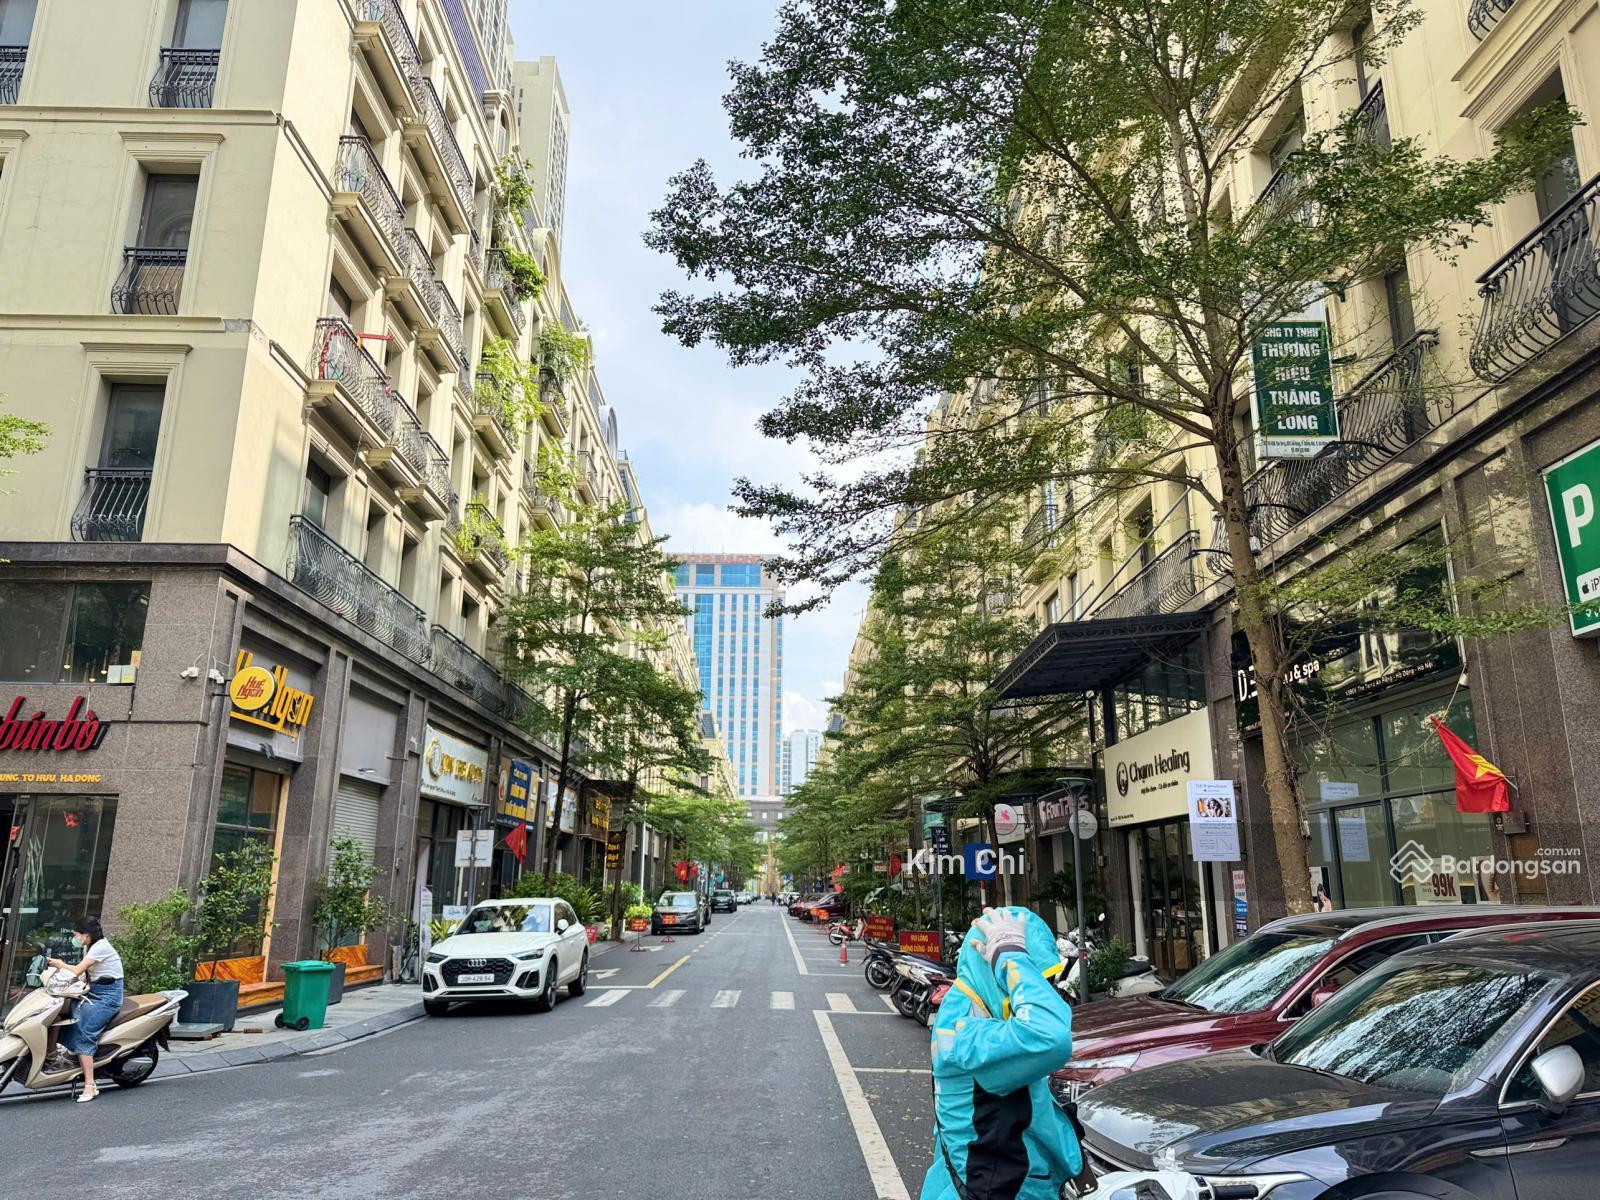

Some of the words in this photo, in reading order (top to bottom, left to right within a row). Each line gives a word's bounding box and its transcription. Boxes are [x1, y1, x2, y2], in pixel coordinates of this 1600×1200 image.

[1284, 328, 1293, 338] TY
[1295, 327, 1319, 338] TNHH
[1277, 415, 1319, 430] LONG
[1561, 482, 1594, 548] P
[1590, 575, 1600, 592] iP
[1302, 660, 1320, 679] spa
[1129, 762, 1154, 783] Chạm
[1154, 749, 1190, 773] Healing
[22, 774, 34, 782] TO
[60, 774, 74, 782] HA
[75, 774, 102, 783] DONG
